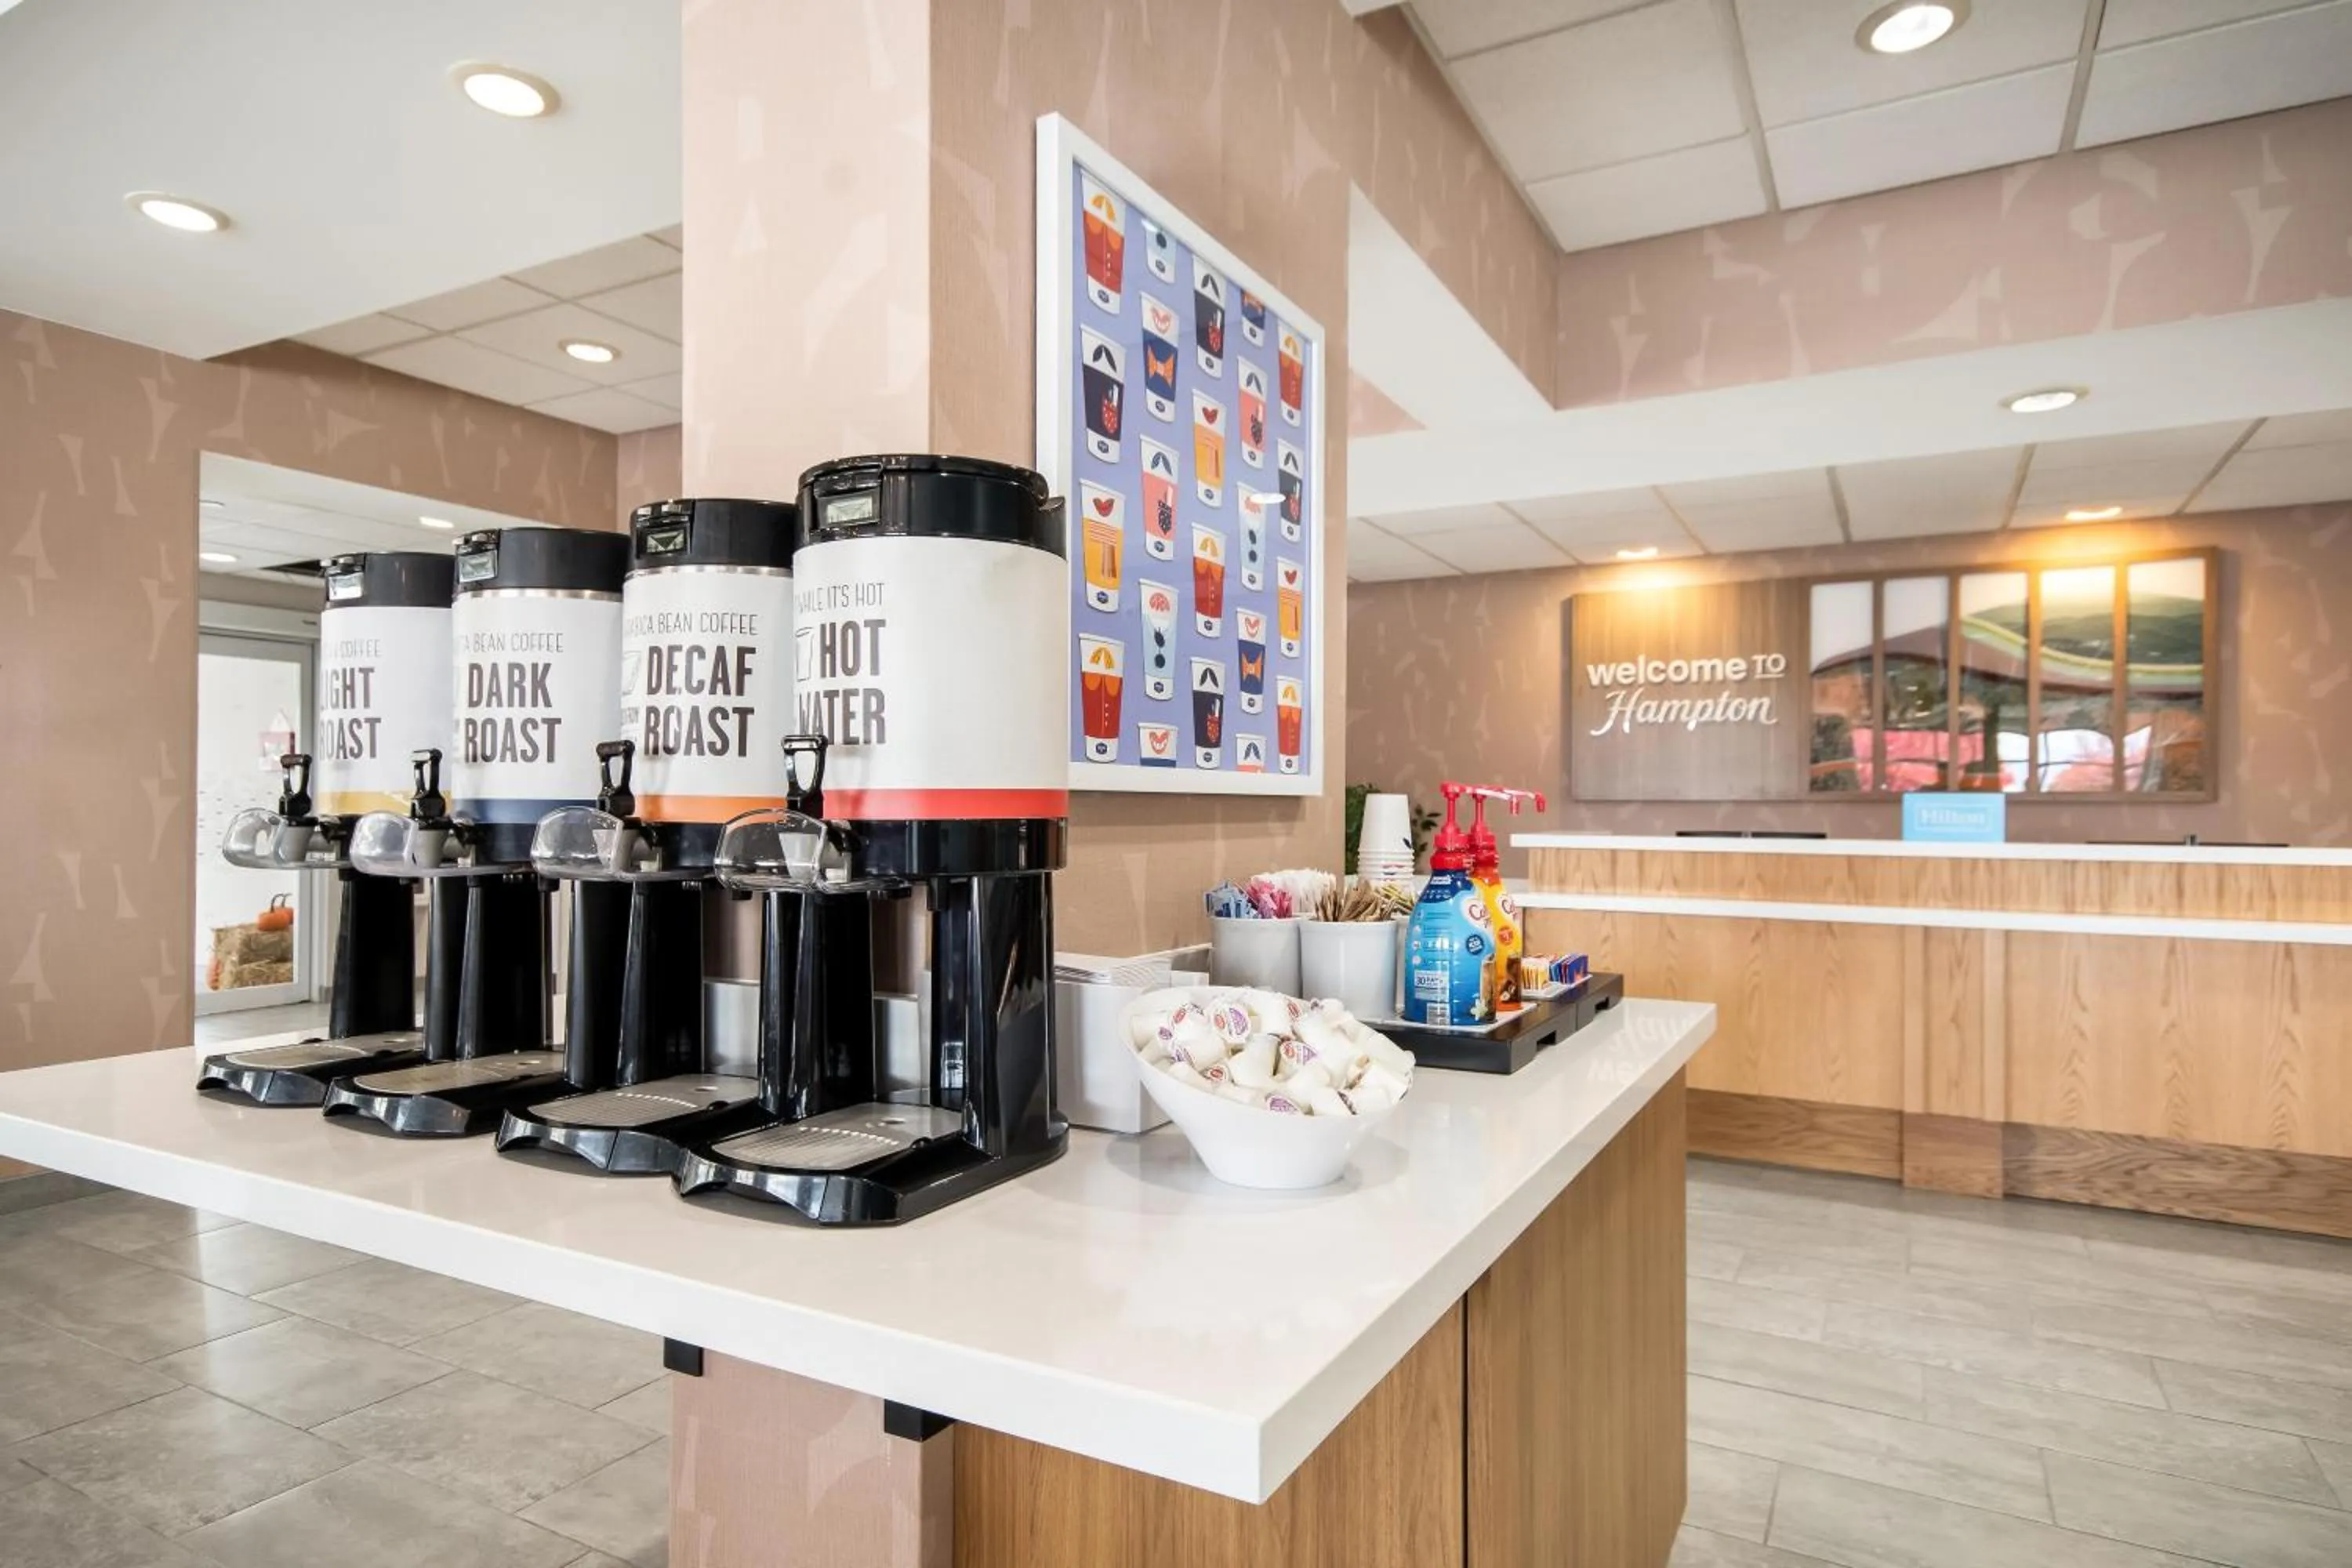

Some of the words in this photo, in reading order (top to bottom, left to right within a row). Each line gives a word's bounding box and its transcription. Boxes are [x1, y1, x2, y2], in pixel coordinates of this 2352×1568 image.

[827, 584, 849, 608] IT'S
[855, 583, 884, 607] HOT
[473, 633, 506, 653] BEAN
[511, 632, 564, 653] COFFEE
[658, 612, 692, 633] BEAN
[700, 612, 758, 636] COFFEE
[647, 644, 757, 696] DECAF
[820, 619, 886, 678] HOT
[1587, 654, 1748, 687] welcome
[1751, 653, 1787, 675] TO
[468, 662, 552, 708] DARK
[644, 705, 754, 757] ROAST
[799, 688, 886, 746] WATER
[1590, 687, 1778, 736] Hampton
[319, 717, 382, 760] ROAST
[464, 717, 562, 764] ROAST
[1921, 808, 1986, 826] Hilton
